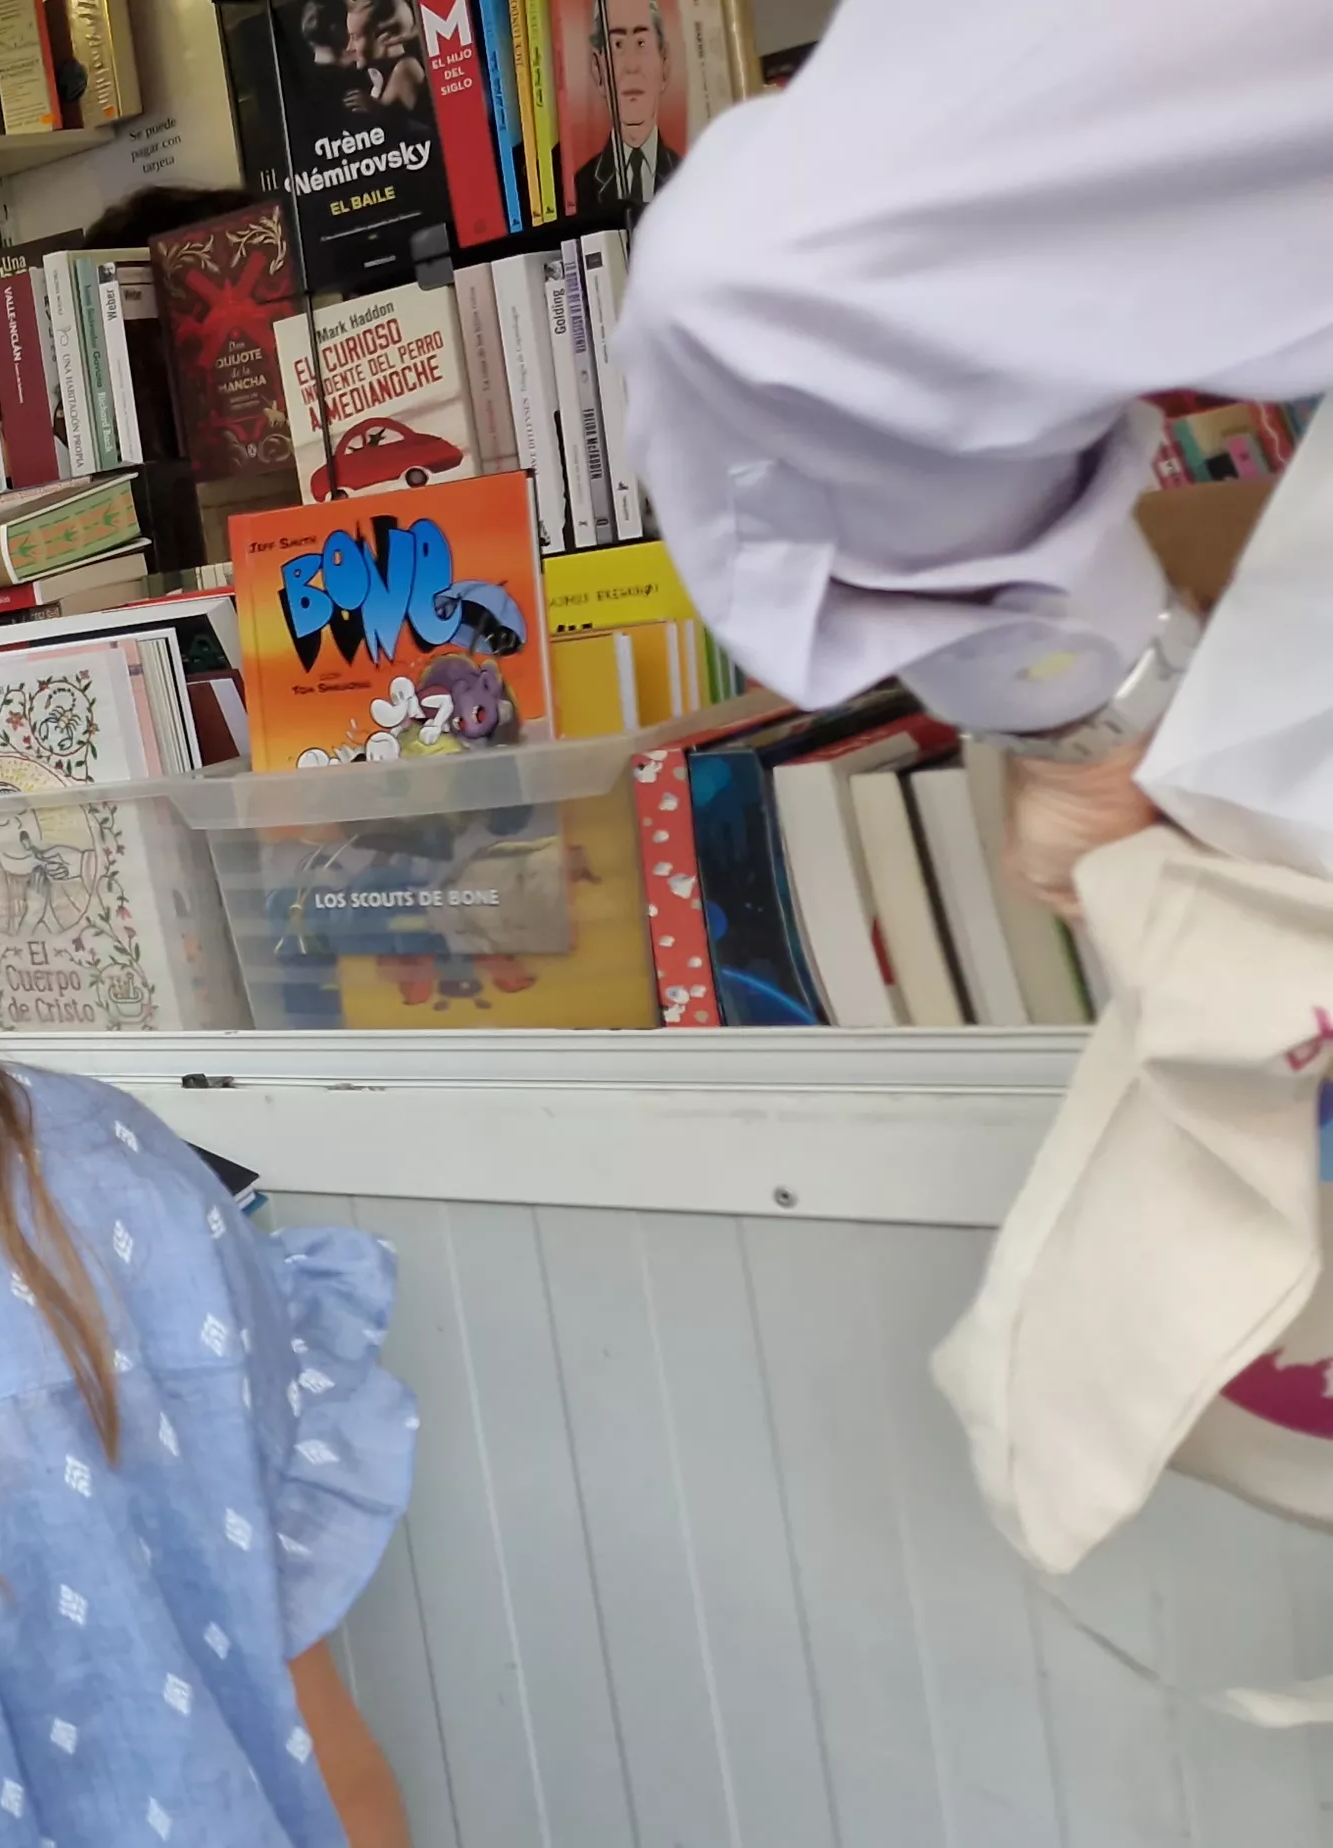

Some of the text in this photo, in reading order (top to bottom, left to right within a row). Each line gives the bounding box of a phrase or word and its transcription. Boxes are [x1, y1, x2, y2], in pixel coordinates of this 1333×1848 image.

[420, 0, 473, 57] M
[432, 48, 473, 71] EL HIJO
[443, 67, 465, 81] DEL
[440, 77, 474, 96] SIGLO
[145, 118, 176, 139] puede
[315, 126, 385, 160] Irène
[131, 135, 181, 163] pagar con
[142, 156, 175, 174] tarjeta
[284, 140, 432, 197] Némirovsky
[329, 185, 397, 216] EL BAILE
[2, 255, 27, 272] Una
[106, 288, 118, 321] Weber
[554, 288, 566, 335] Golding
[3, 286, 23, 362] VALLE-INCLÁN
[316, 302, 395, 344] Mark Haddon
[294, 317, 403, 387] EL CURIOSO
[367, 352, 396, 377] DEL
[398, 330, 444, 364] PERRO
[218, 374, 267, 392] MANCHA
[308, 354, 444, 432] A MEDIANOCHE
[70, 434, 85, 468] PROPIA
[249, 541, 275, 554] JEFF
[280, 517, 463, 667] BONE
[315, 889, 500, 909] LOS SCOUTS DE BONE
[27, 941, 50, 966] El
[5, 964, 81, 997] Cuerpo
[8, 996, 95, 1023] de Cristo
